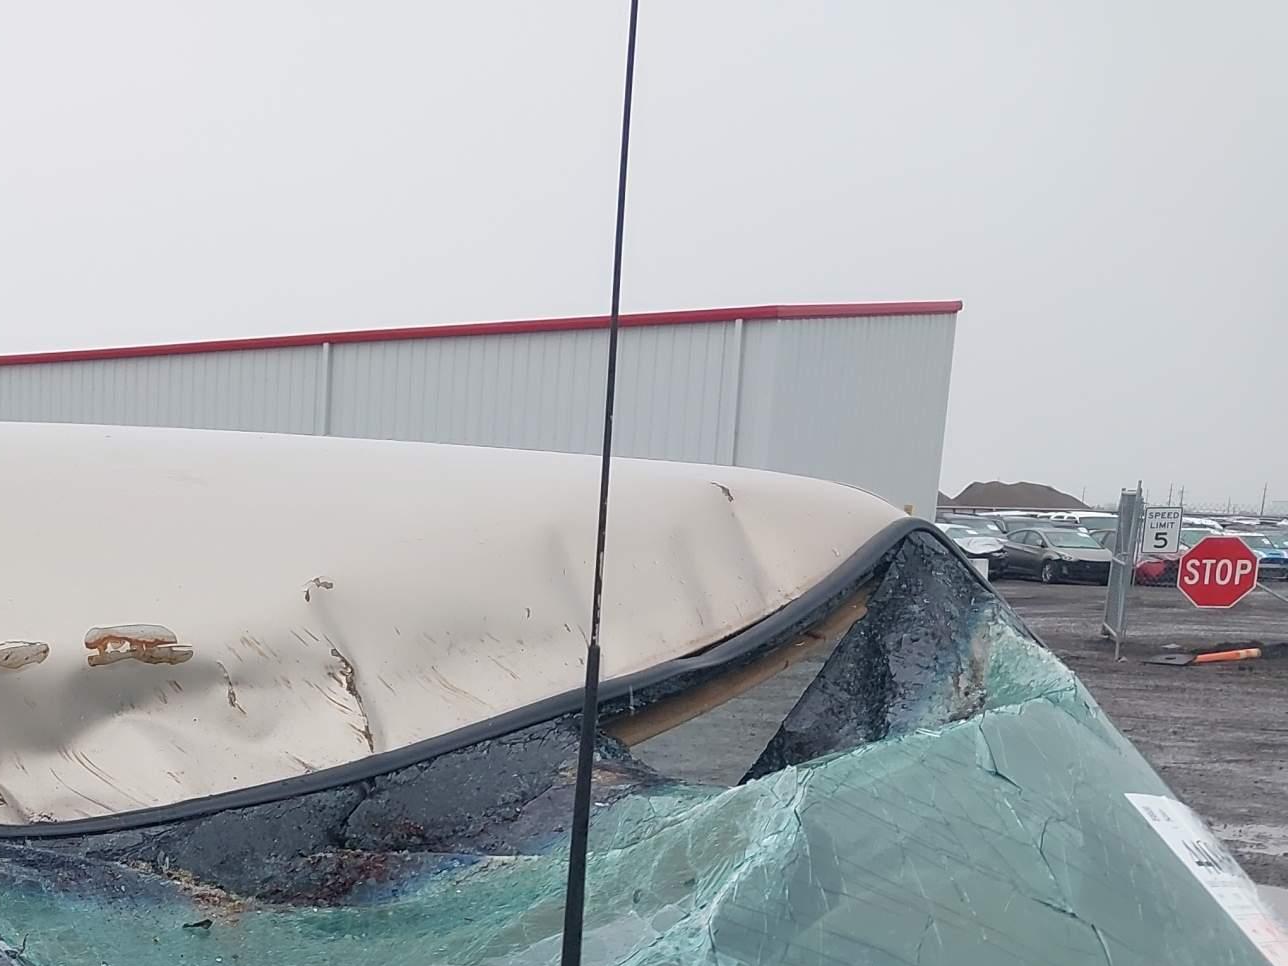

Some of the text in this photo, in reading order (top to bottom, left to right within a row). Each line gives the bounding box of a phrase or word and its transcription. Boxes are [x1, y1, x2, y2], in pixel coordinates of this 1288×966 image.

[1148, 511, 1180, 519] SPEED
[1150, 521, 1175, 529] LIMIT
[1153, 532, 1168, 549] 5
[1183, 558, 1253, 586] STOP
